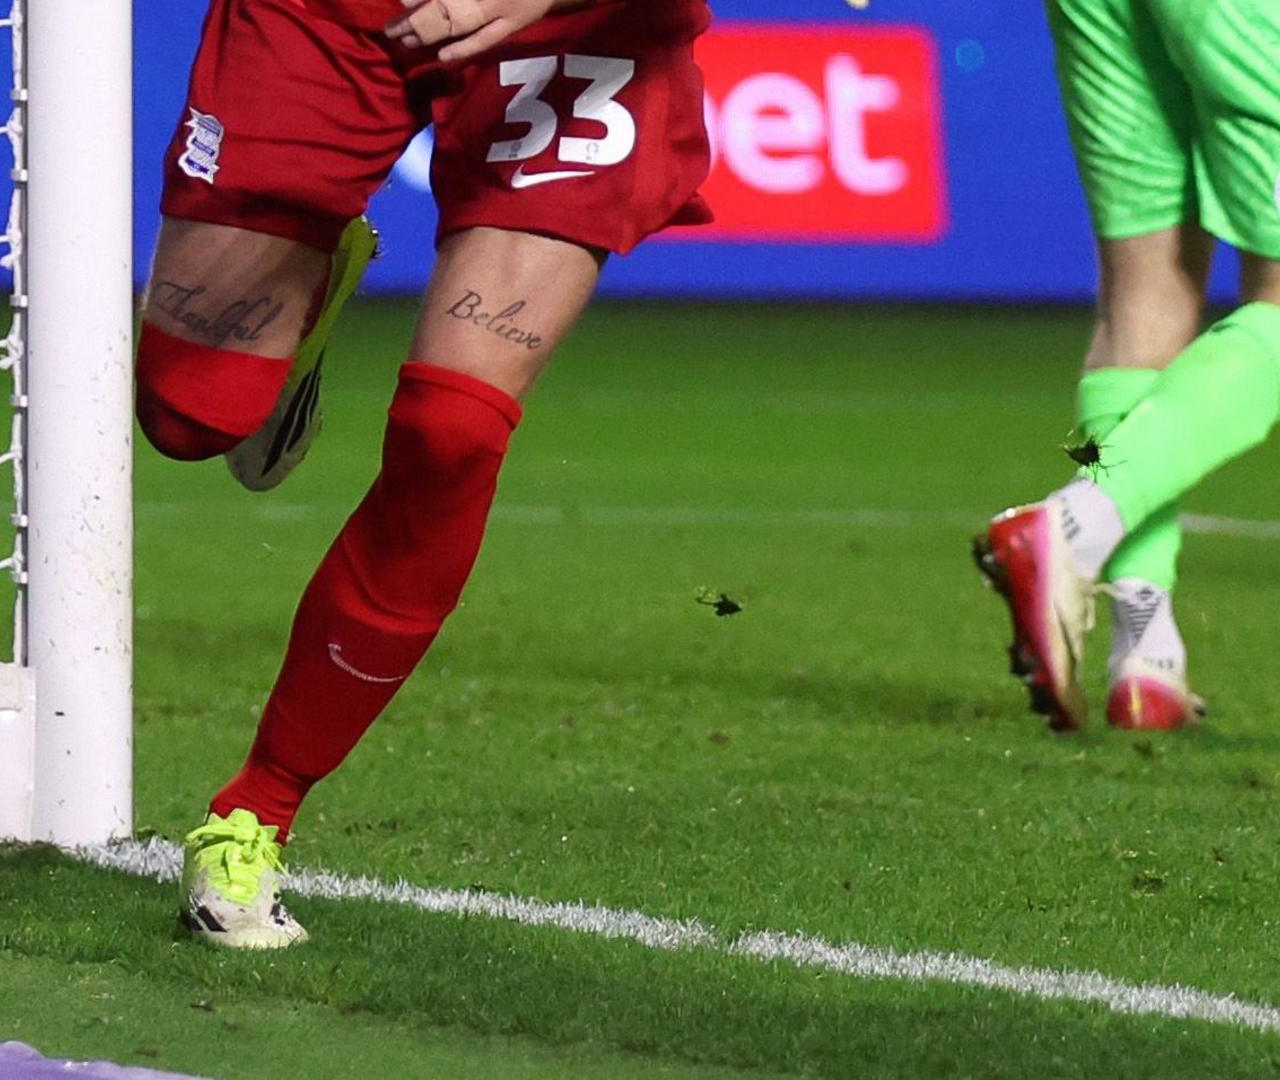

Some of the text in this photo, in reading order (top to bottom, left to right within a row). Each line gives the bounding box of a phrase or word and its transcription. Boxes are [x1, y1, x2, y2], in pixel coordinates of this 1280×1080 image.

[485, 53, 636, 166] 33
[703, 52, 913, 196] et
[446, 290, 541, 350] Believe
